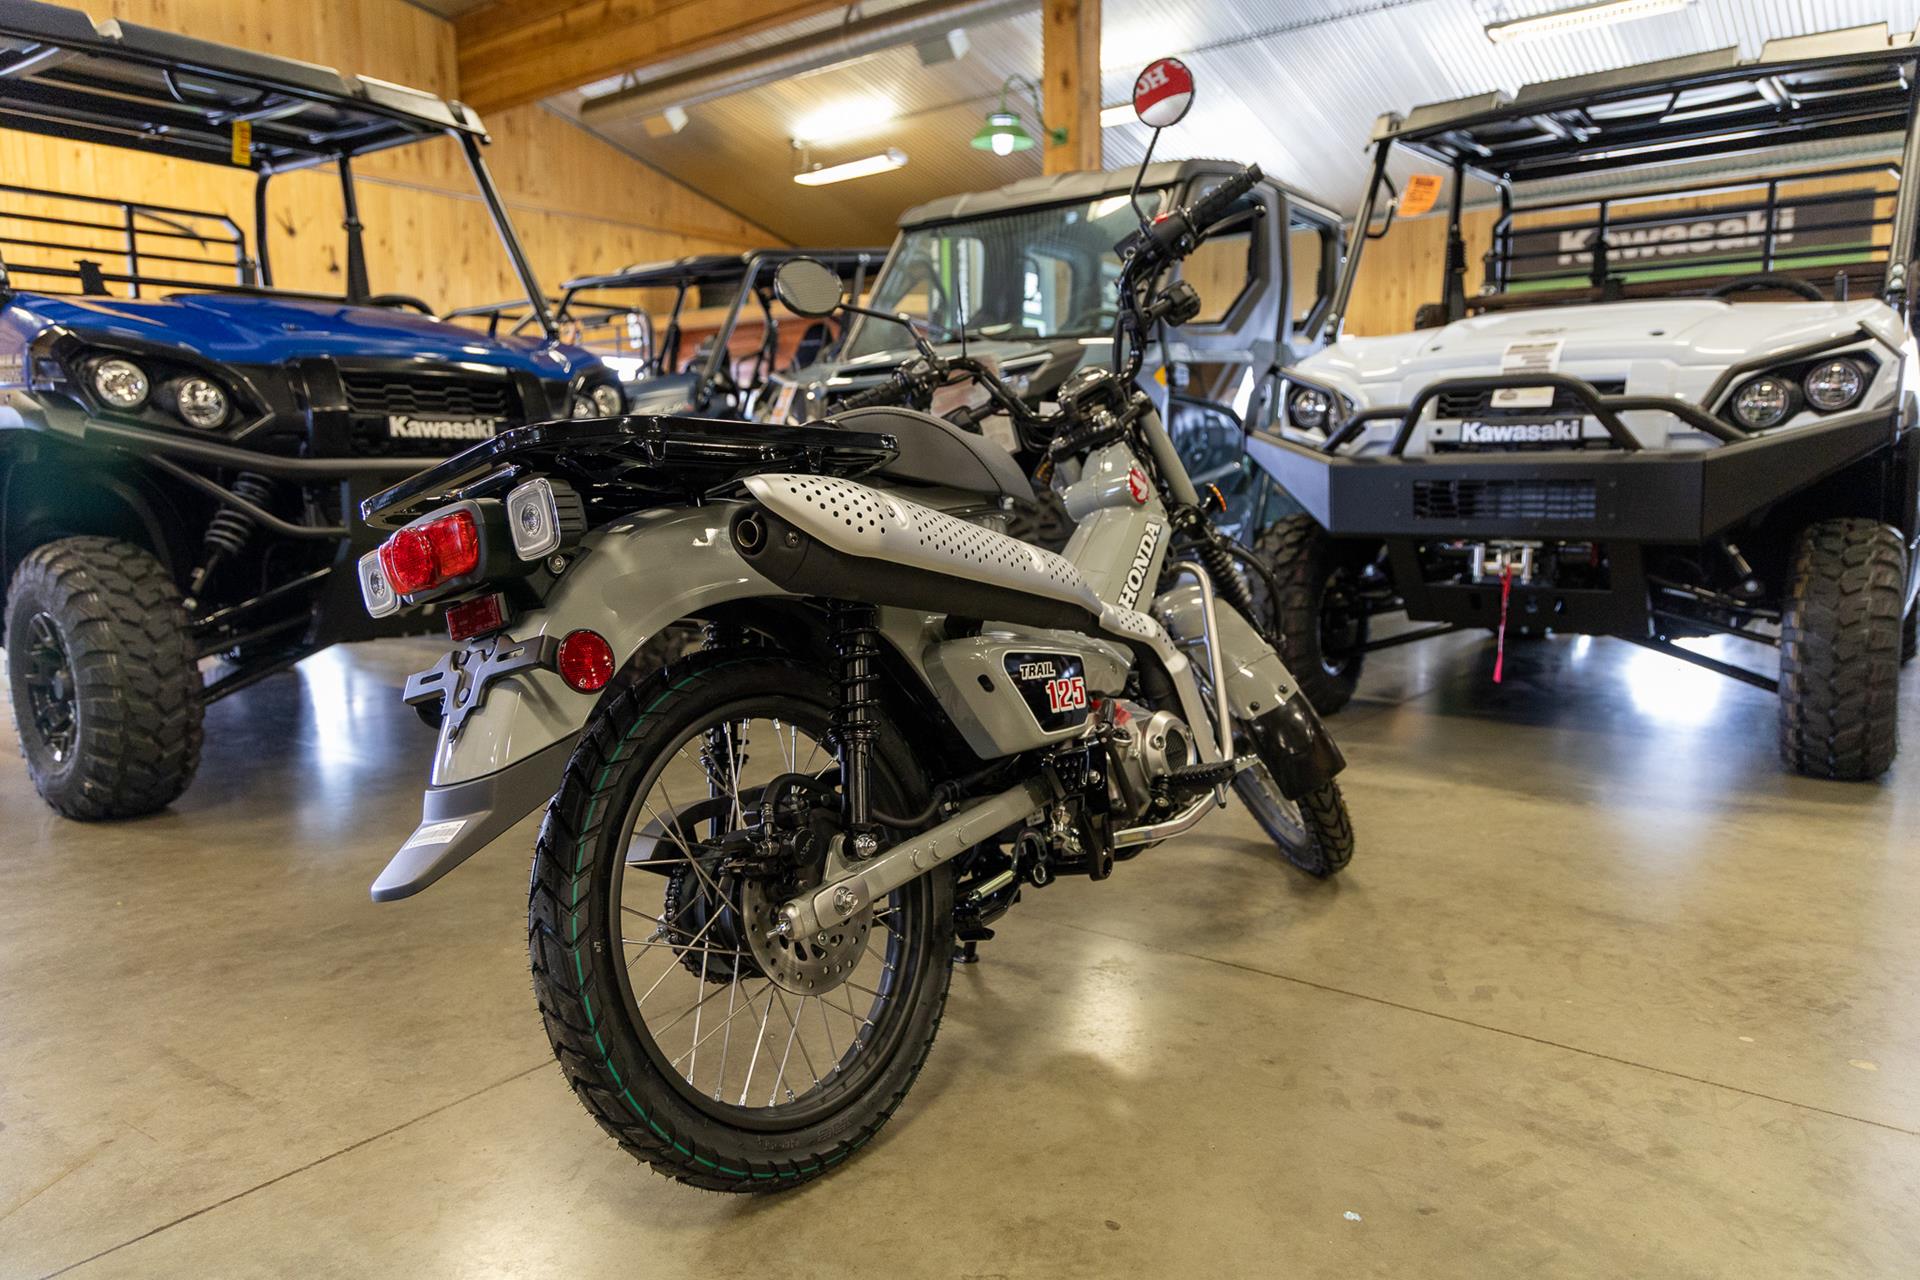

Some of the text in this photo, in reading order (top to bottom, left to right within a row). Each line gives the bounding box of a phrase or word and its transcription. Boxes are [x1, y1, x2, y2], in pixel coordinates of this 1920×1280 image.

[388, 415, 495, 439] Kawasaki
[1461, 420, 1580, 442] Kawasaki
[1117, 521, 1161, 611] HONDA
[1020, 661, 1056, 680] TRAIL
[1045, 676, 1087, 713] 125
